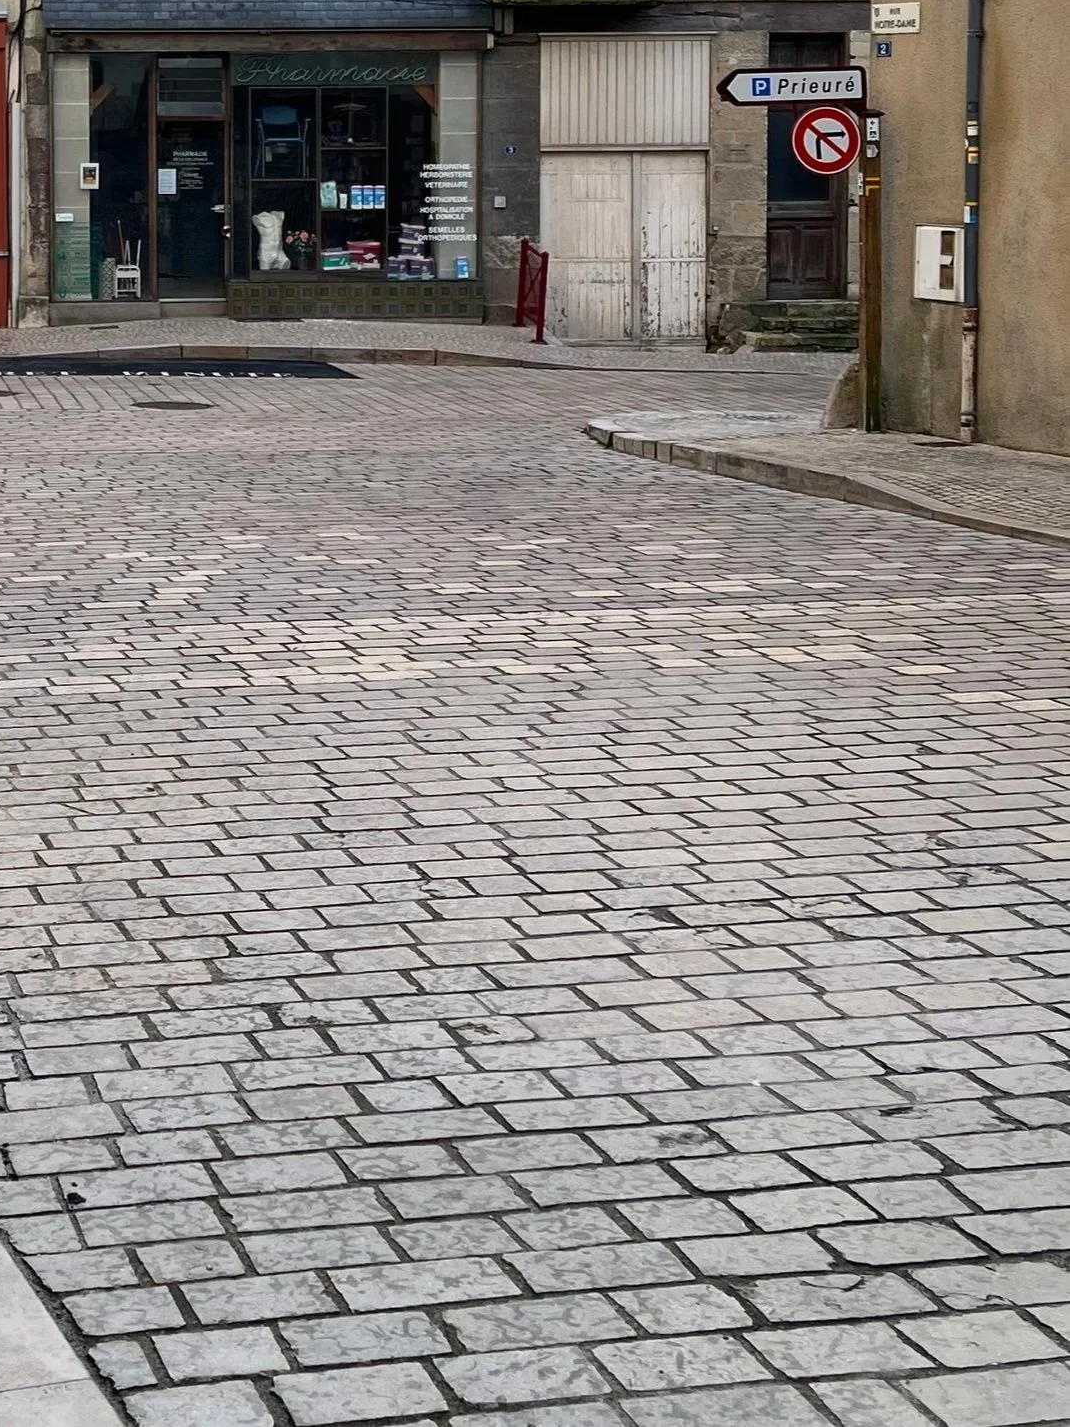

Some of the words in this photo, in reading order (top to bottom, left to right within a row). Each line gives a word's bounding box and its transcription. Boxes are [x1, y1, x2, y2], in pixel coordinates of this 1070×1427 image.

[874, 18, 916, 29] NOTRE-DAME
[880, 44, 887, 54] 2
[236, 55, 428, 83] Pharmacie
[777, 76, 856, 95] Prieuré
[435, 213, 466, 221] DOMICILE
[428, 226, 466, 234] SEMELLES
